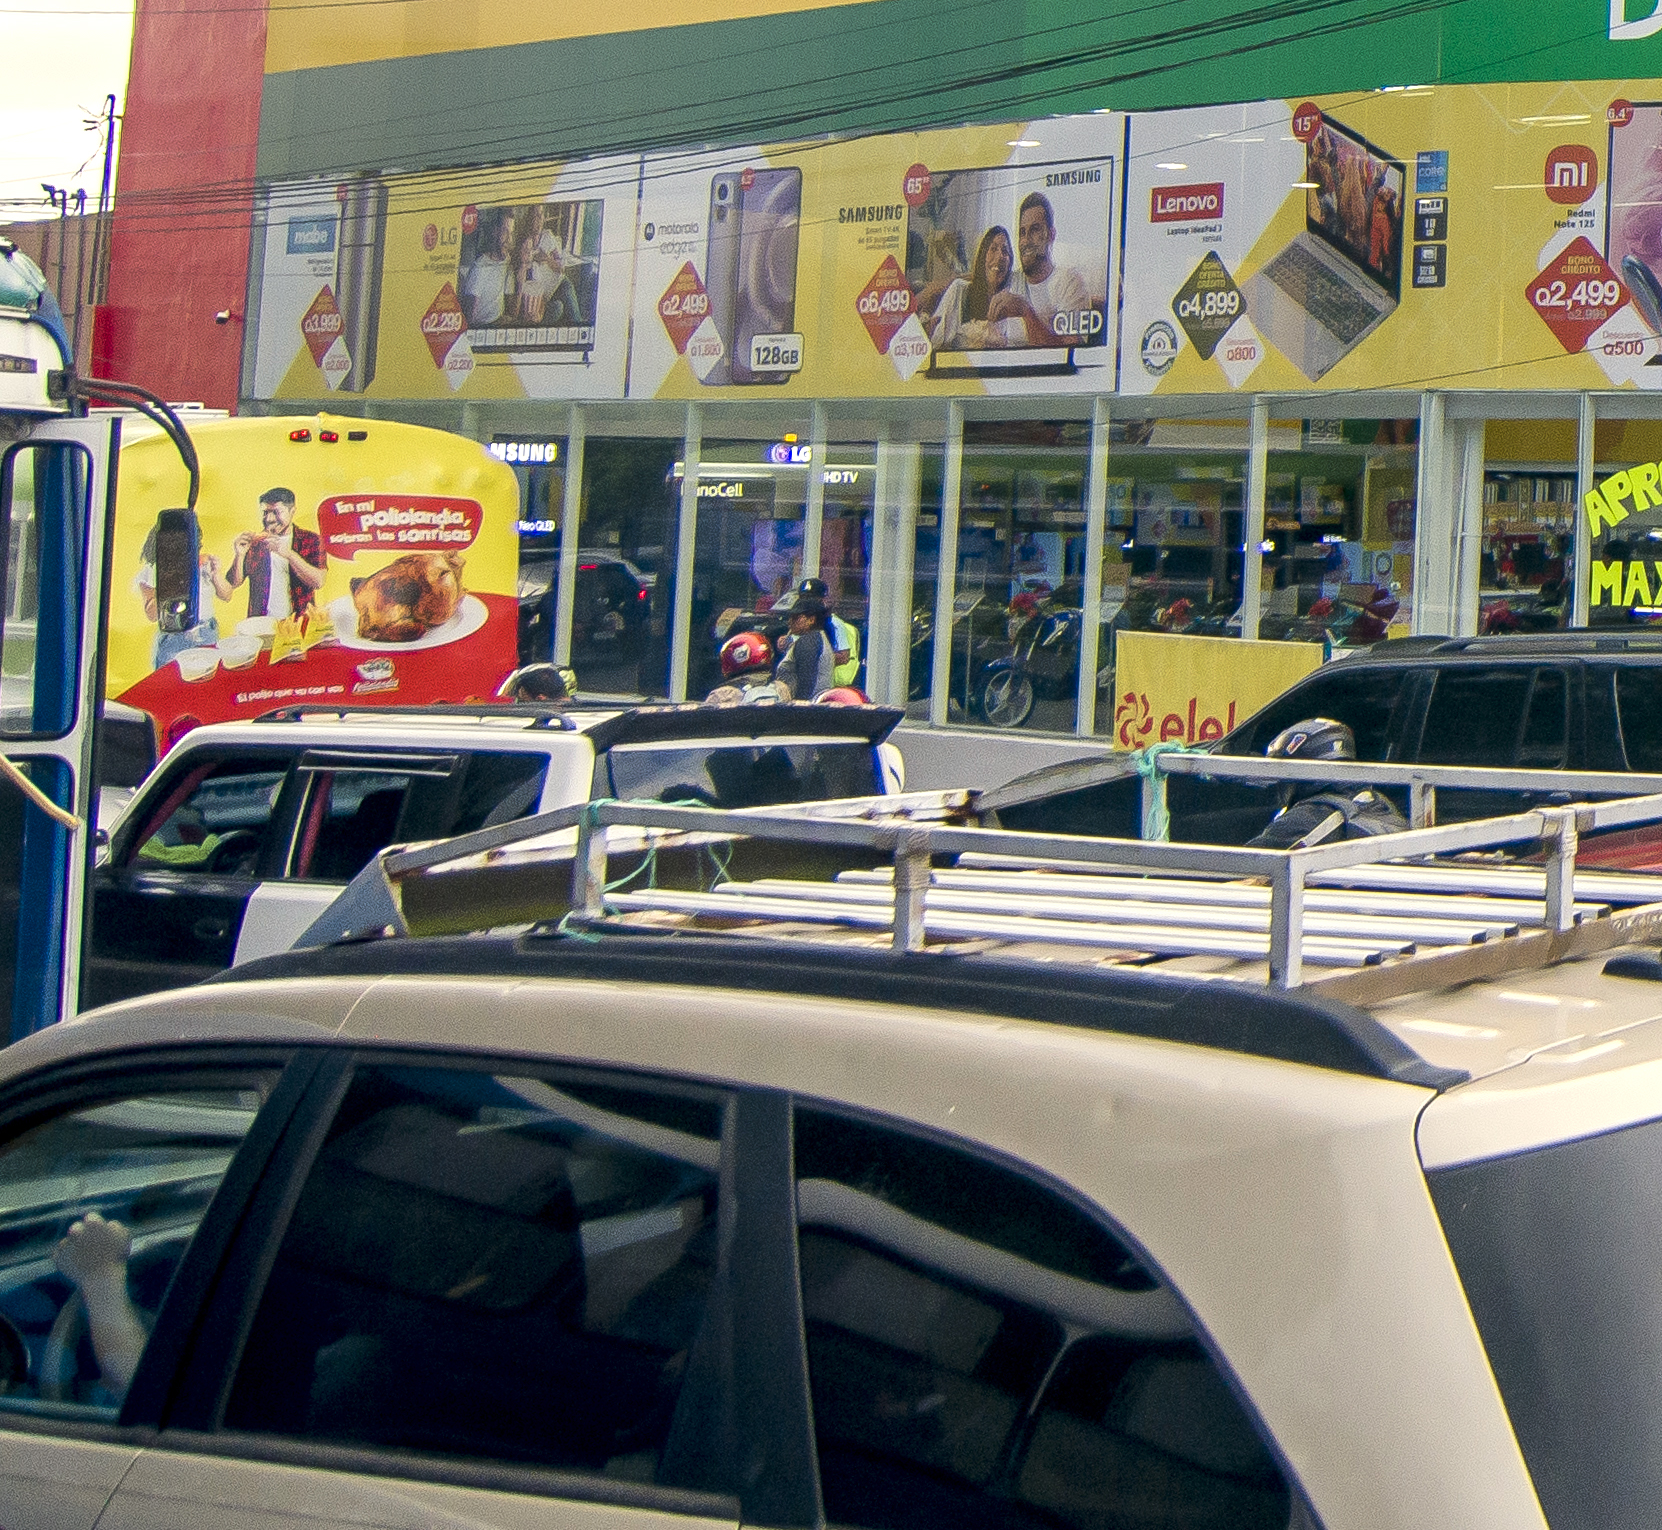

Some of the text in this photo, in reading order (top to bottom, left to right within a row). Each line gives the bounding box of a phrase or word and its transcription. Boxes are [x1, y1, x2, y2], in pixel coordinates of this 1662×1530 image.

[1045, 169, 1102, 188] SAMSUNG
[1155, 193, 1219, 215] Lenovo
[1566, 209, 1596, 219] Redmi
[838, 205, 904, 225] SAMSUNG
[1553, 219, 1576, 229] Note
[440, 226, 458, 246] LG
[661, 292, 709, 317] Q2,499
[858, 290, 911, 317] Q6,499
[1178, 290, 1241, 320] Q4,899
[1534, 281, 1621, 311] Q2,499
[1052, 310, 1104, 338] QLED
[754, 346, 799, 366] 128GB
[1602, 342, 1645, 357] Q500
[790, 445, 812, 463] LG
[335, 501, 354, 515] En
[397, 526, 472, 544] sonrisas
